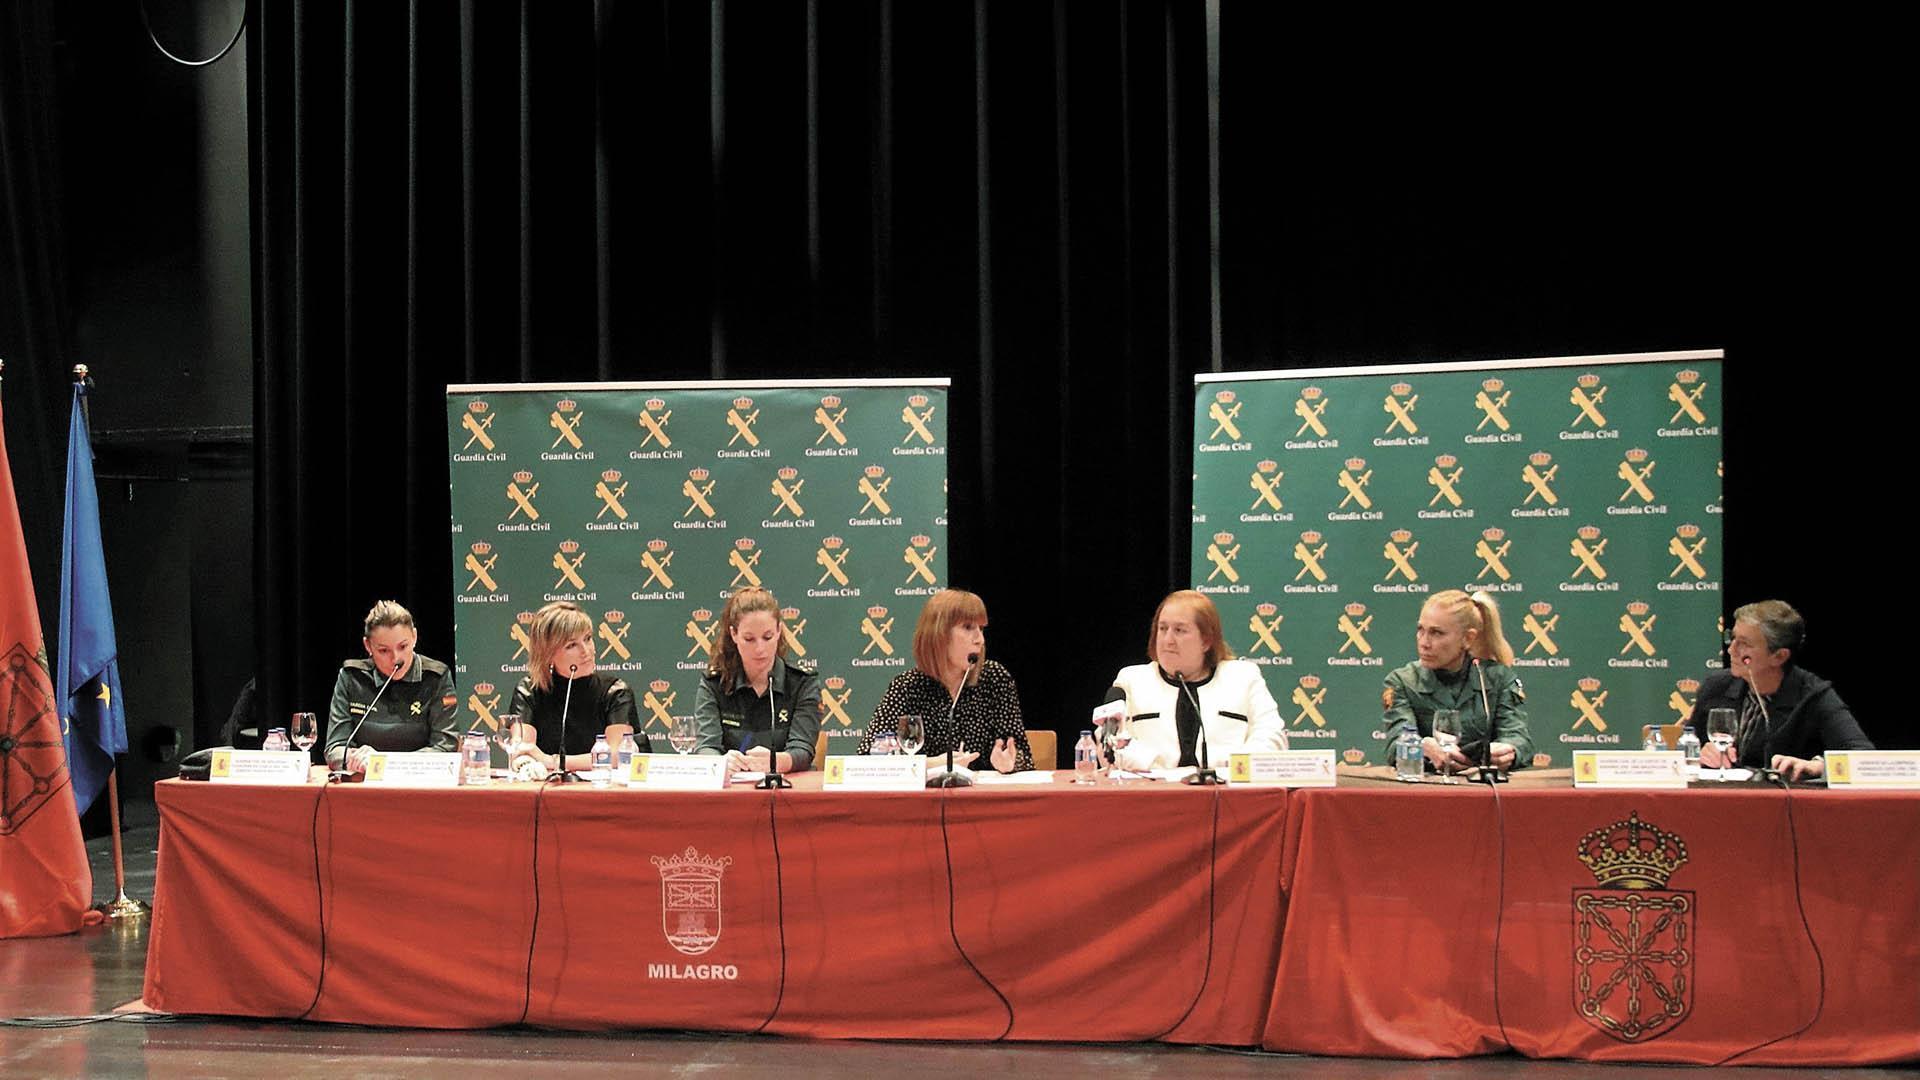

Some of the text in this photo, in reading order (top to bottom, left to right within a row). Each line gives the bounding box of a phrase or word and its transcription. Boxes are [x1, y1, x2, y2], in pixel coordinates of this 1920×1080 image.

[1558, 429, 1619, 440] Guardia Civil
[1656, 426, 1719, 437] Guardia Civil
[1372, 435, 1430, 447] Guardia Civil
[1464, 433, 1522, 444] Guardia Civil
[1198, 441, 1253, 453] Guardia Civil
[1284, 439, 1339, 450] Guardia Civil
[453, 452, 507, 462] Guardia Civil
[540, 451, 595, 461] Guardia Civil
[629, 450, 683, 460] Guardia Civil
[716, 448, 771, 459] Guardia Civil
[804, 447, 859, 457] Guardia Civil
[892, 446, 947, 457] Guardia Civil
[1417, 508, 1475, 519] Guardia Civil
[1511, 507, 1570, 518] Guardia Civil
[1606, 504, 1668, 515] Guardia Civil
[848, 516, 903, 527] Guardia Civil
[1239, 512, 1294, 523] Guardia Civil
[1327, 511, 1384, 522] Guardia Civil
[497, 522, 551, 532] Guardia Civil
[585, 521, 640, 531] Guardia Civil
[672, 519, 727, 530] Guardia Civil
[761, 519, 815, 529] Guardia Civil
[894, 586, 927, 597] Guardia
[1195, 584, 1251, 594] Guardia Civil
[1283, 583, 1339, 594] Guardia Civil
[1372, 583, 1430, 593] Guardia Civil
[1463, 583, 1523, 593] Guardia Civil
[1558, 581, 1619, 592] Guardia Civil
[1656, 581, 1719, 591] Guardia Civil
[542, 592, 597, 602] Guardia Civil
[631, 591, 685, 601] Guardia Civil
[806, 587, 861, 598] Guardia Civil
[456, 593, 509, 604] Guardia Civil
[594, 661, 642, 671] uardia Civil
[676, 661, 709, 670] Guardia
[851, 657, 906, 667] Guardia Civil
[1272, 655, 1294, 666] Civil
[1327, 656, 1384, 667] Guardia Civil
[1548, 657, 1571, 667] Civil
[1607, 657, 1669, 668] Guardia Civil
[825, 728, 863, 738] rdia Civil
[1316, 728, 1338, 739] Civil
[1558, 733, 1621, 744] Guardia Civil
[648, 963, 739, 980] MILAGRO
